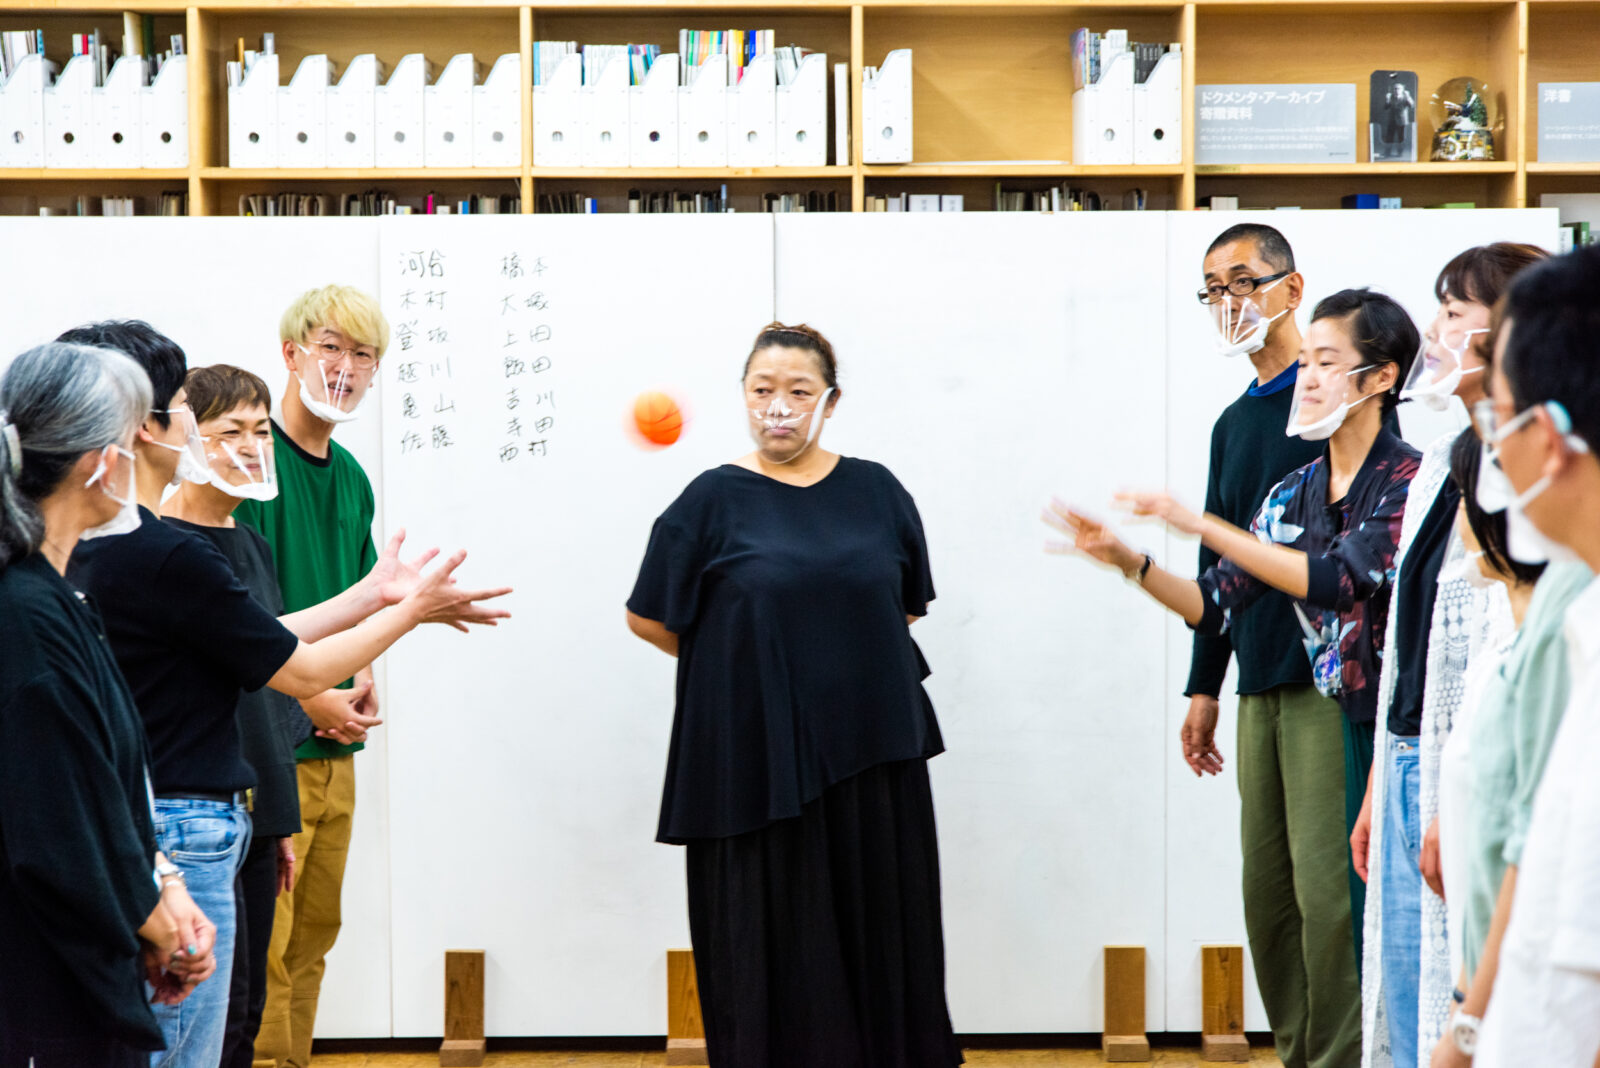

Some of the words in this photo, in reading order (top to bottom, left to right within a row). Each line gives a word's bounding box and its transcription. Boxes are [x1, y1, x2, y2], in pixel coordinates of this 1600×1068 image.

[1201, 89, 1327, 105] ドクメンタ・アーカイブ
[399, 249, 446, 278] 河合
[500, 251, 549, 279] 橋本
[400, 289, 447, 310] 木村
[503, 323, 552, 348] 上田
[506, 387, 556, 411] 吉川
